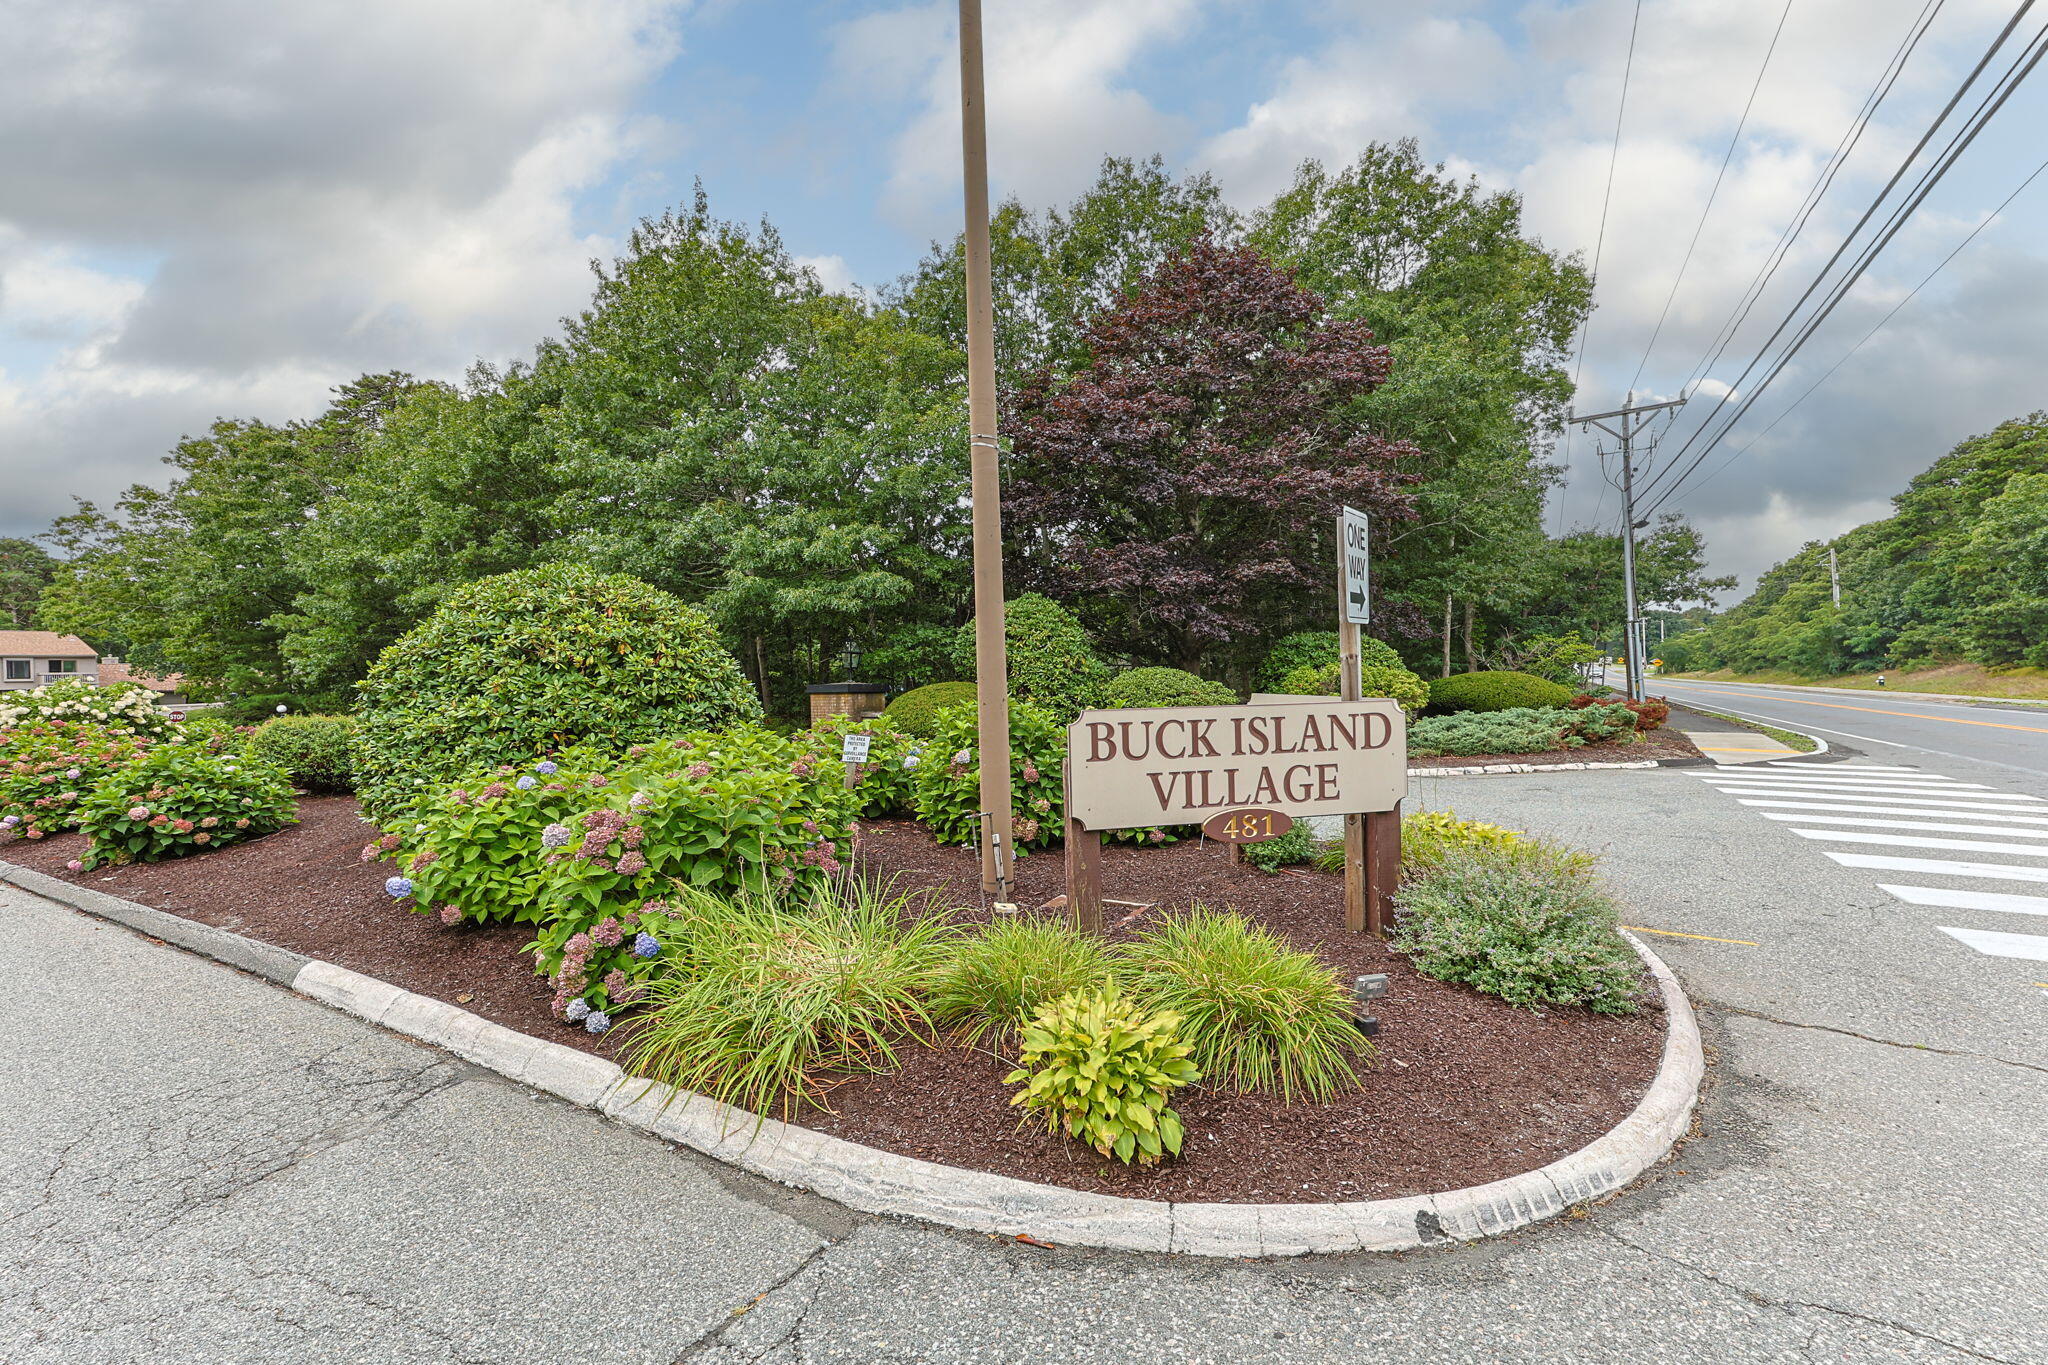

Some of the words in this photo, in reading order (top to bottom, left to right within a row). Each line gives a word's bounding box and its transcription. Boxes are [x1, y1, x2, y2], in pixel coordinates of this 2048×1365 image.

[1347, 523, 1365, 551] ONE
[1348, 554, 1365, 581] WAY
[1085, 718, 1221, 763] BUCK
[1231, 712, 1392, 756] ISLAND
[1146, 763, 1340, 811] VILLAGE
[1222, 814, 1275, 839] 481
